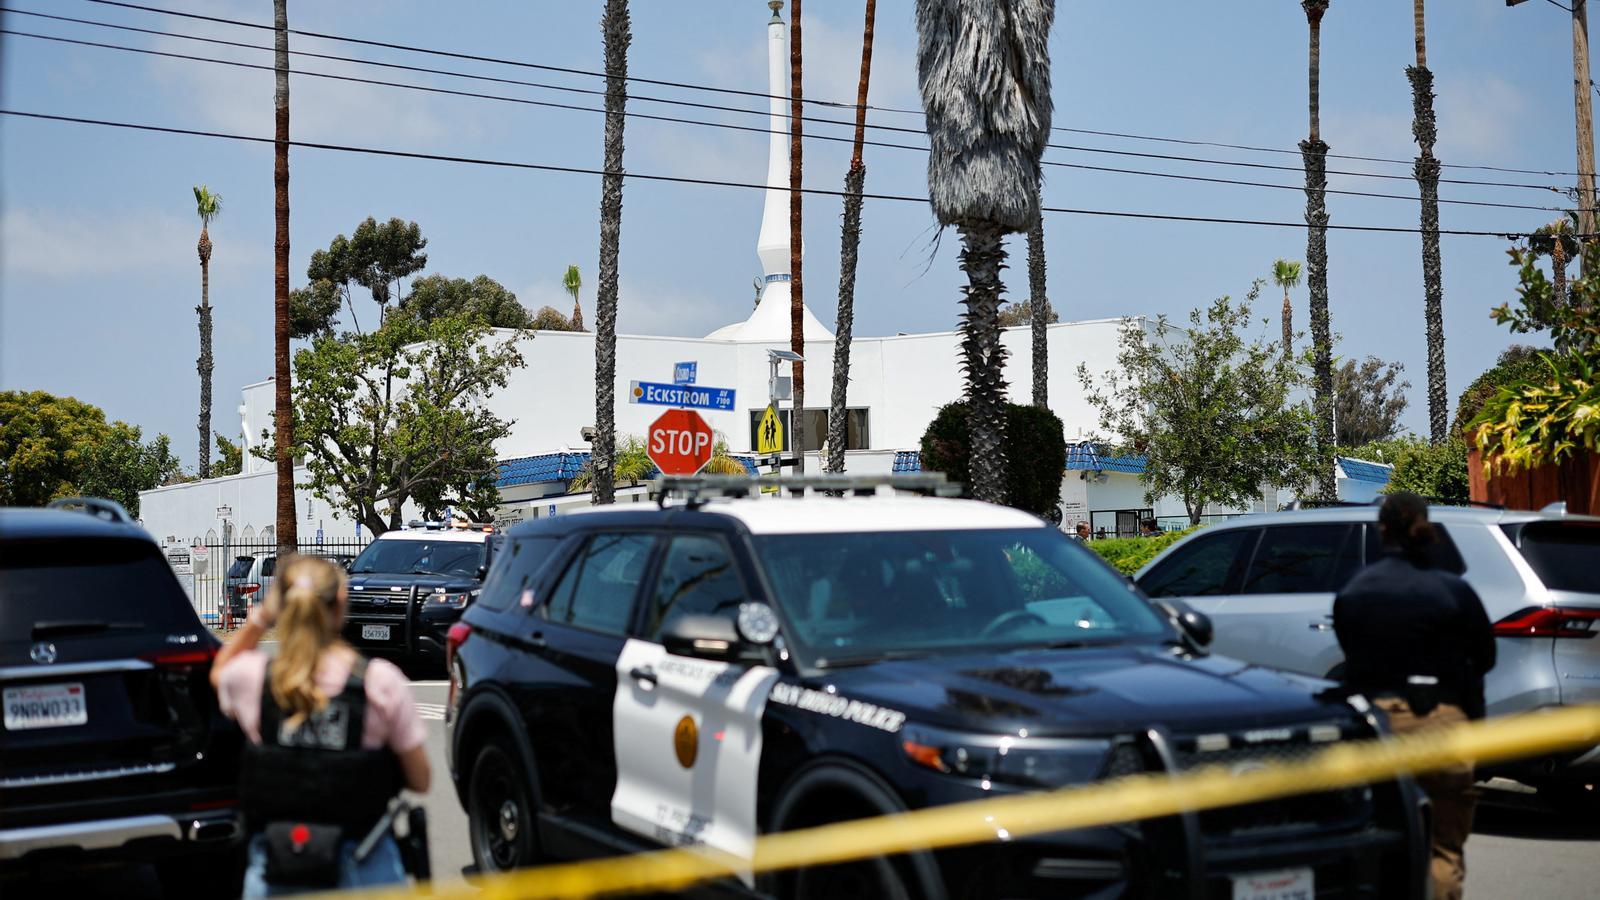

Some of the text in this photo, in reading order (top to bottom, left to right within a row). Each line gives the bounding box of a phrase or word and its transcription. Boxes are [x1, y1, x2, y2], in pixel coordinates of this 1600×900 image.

[647, 386, 709, 406] ECKSTROM
[716, 397, 730, 405] 7100
[651, 428, 709, 456] STOP
[841, 700, 906, 732] POLICE
